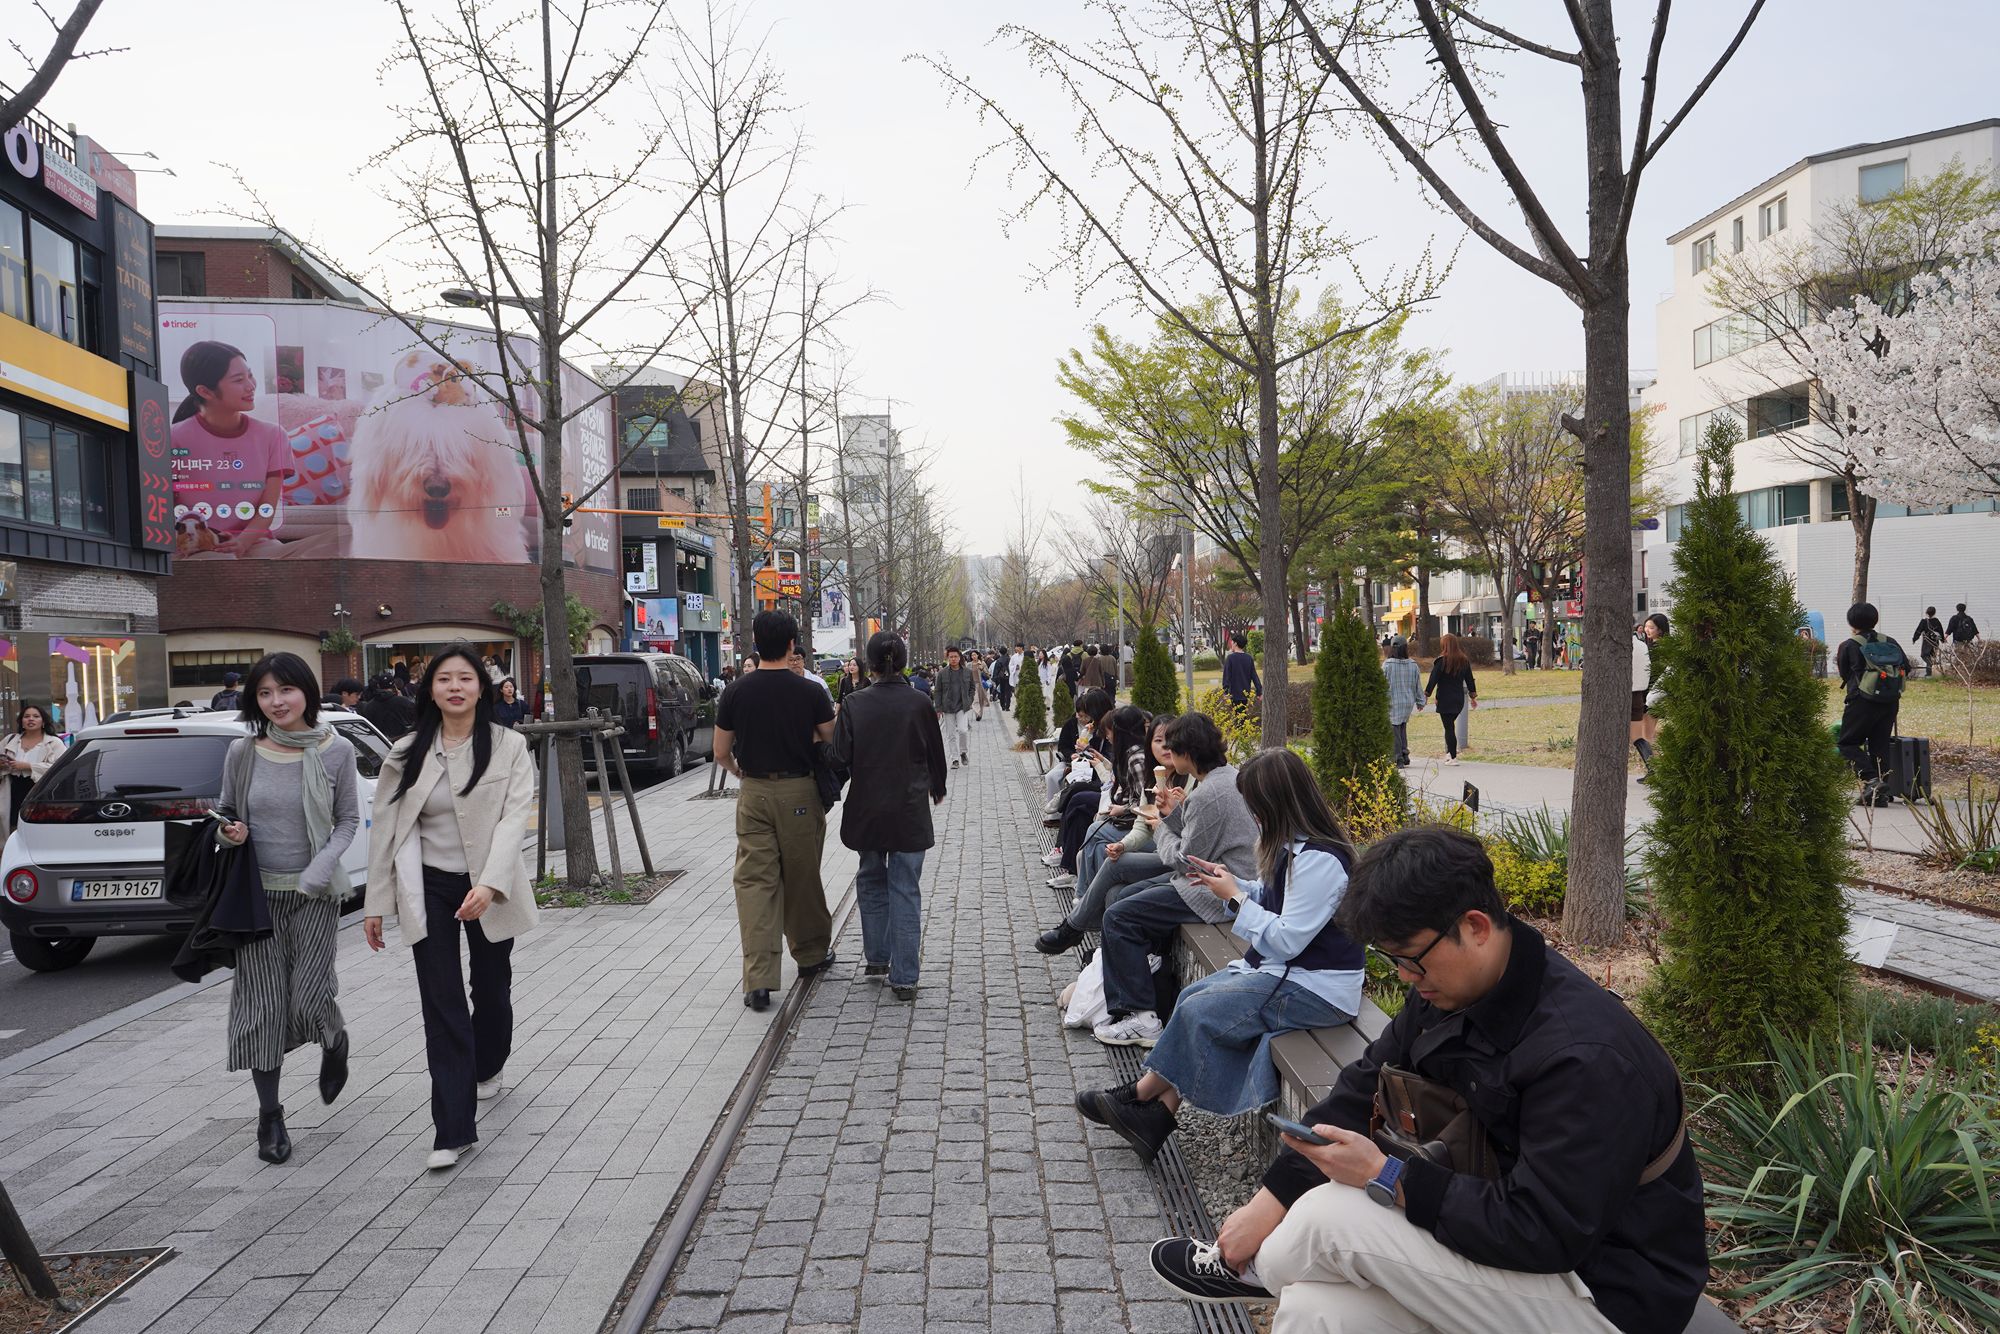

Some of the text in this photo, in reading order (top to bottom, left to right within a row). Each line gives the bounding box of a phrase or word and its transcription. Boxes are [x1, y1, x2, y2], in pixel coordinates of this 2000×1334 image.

[171, 320, 197, 329] tinder
[216, 460, 230, 470] 23
[148, 494, 168, 523] 2F
[590, 530, 609, 553] tinder
[94, 827, 136, 838] casper
[85, 881, 159, 898] 191가 9167
